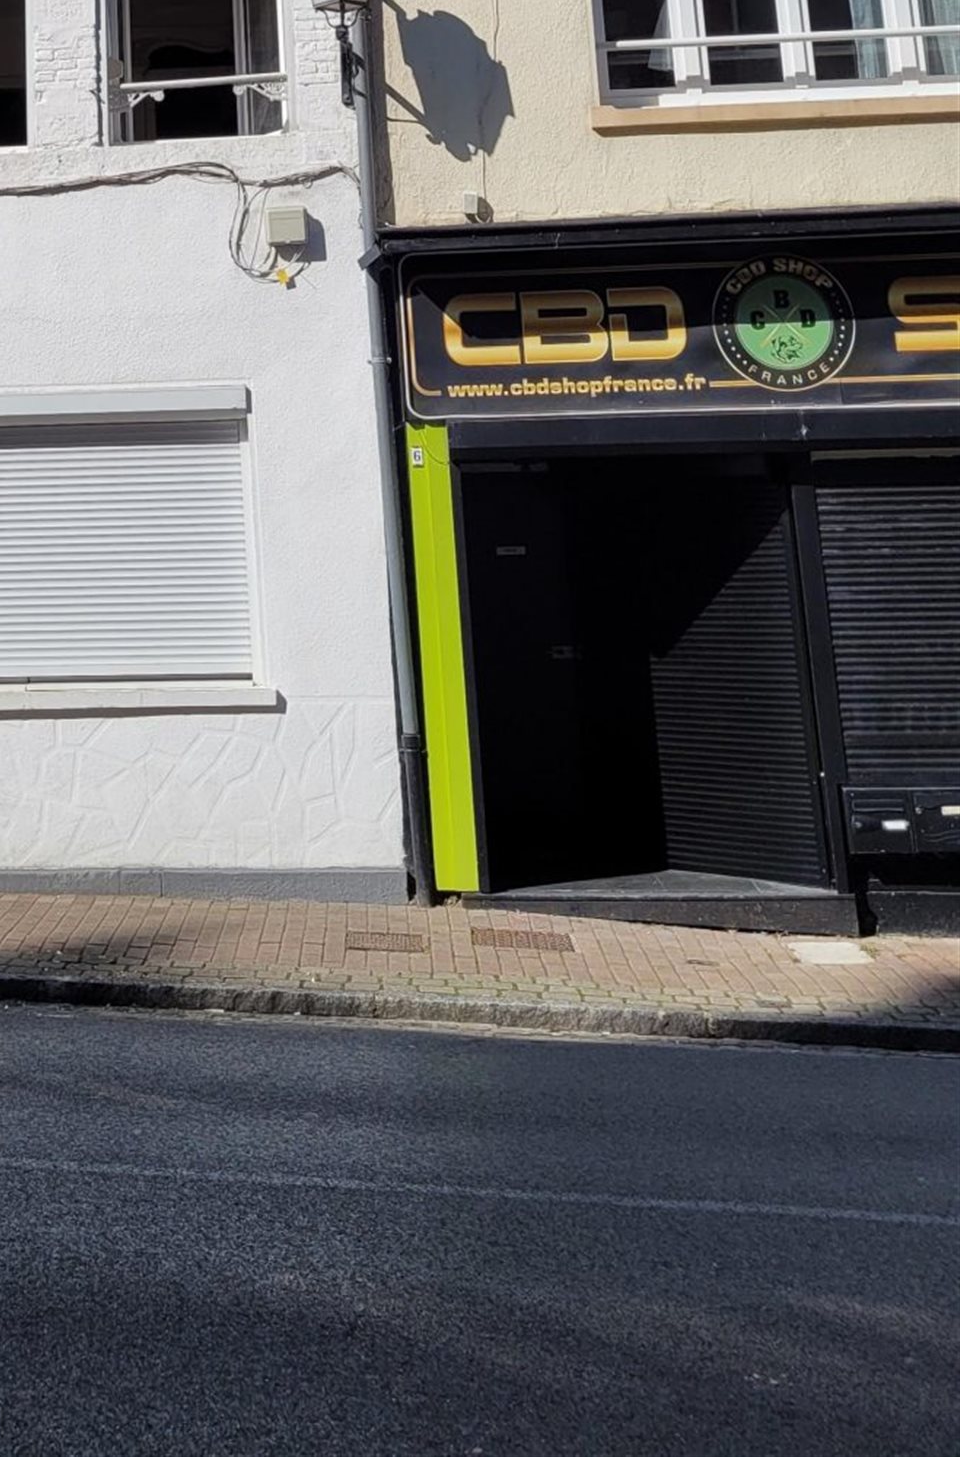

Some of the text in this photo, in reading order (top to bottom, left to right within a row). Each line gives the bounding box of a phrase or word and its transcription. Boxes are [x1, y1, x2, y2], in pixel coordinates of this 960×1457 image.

[773, 257, 834, 289] SHOP
[443, 286, 687, 366] CBD
[447, 373, 706, 398] www.cbdshopfrance.fr
[748, 362, 830, 385] FRANCE
[413, 450, 421, 462] 6
